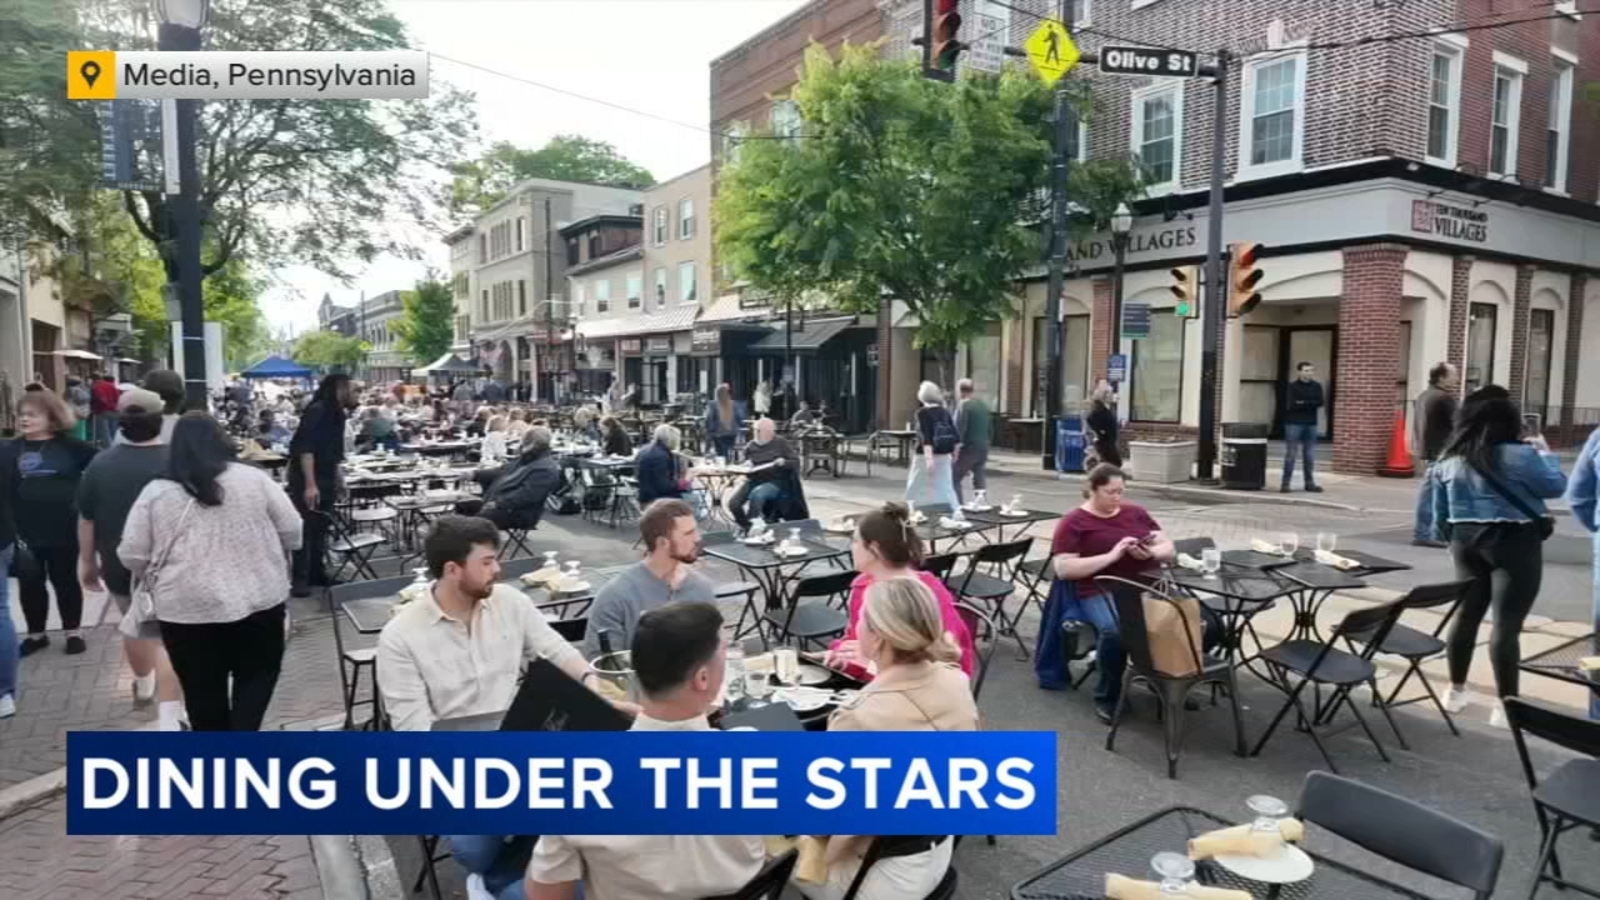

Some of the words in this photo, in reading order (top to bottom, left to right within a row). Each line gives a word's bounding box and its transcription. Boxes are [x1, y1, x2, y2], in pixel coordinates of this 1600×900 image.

[1106, 50, 1160, 71] Olive
[1167, 53, 1192, 72] St
[1107, 226, 1197, 254] VLLAGES
[1435, 216, 1487, 243] VILLAGES
